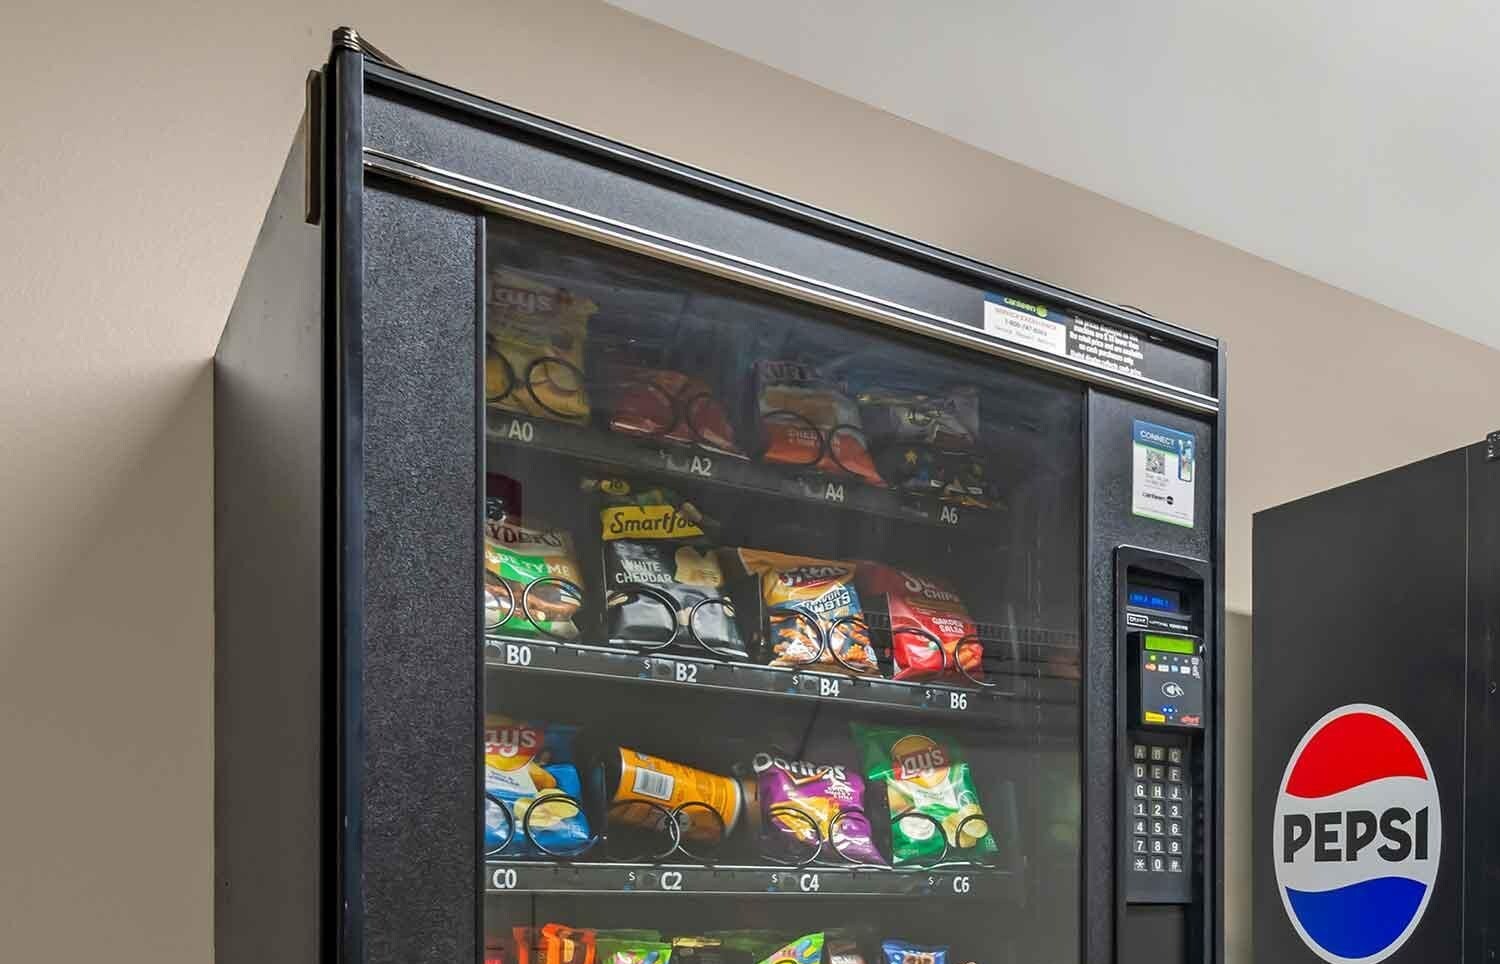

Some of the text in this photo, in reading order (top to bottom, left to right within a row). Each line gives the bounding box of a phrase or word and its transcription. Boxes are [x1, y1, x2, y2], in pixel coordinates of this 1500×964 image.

[508, 420, 533, 441] A0
[1140, 430, 1175, 446] CONNECT
[690, 457, 712, 476] A2
[825, 483, 844, 502] A4
[940, 506, 958, 524] A6
[620, 560, 661, 573] WHITE
[615, 572, 672, 584] CHEDDAR
[507, 645, 531, 665] B0
[676, 663, 697, 682] B2
[820, 679, 840, 697] B4
[950, 692, 967, 710] B6
[753, 753, 847, 780] Doritos
[1136, 785, 1178, 798] G H J
[1137, 803, 1178, 816] 1 2 3
[1136, 821, 1178, 834] 4 5 6
[1283, 806, 1429, 863] PEPSI
[1137, 840, 1178, 852] 7 8 9
[492, 869, 517, 889] C0
[661, 872, 682, 890] C2
[800, 874, 819, 892] C4
[953, 877, 970, 893] C6
